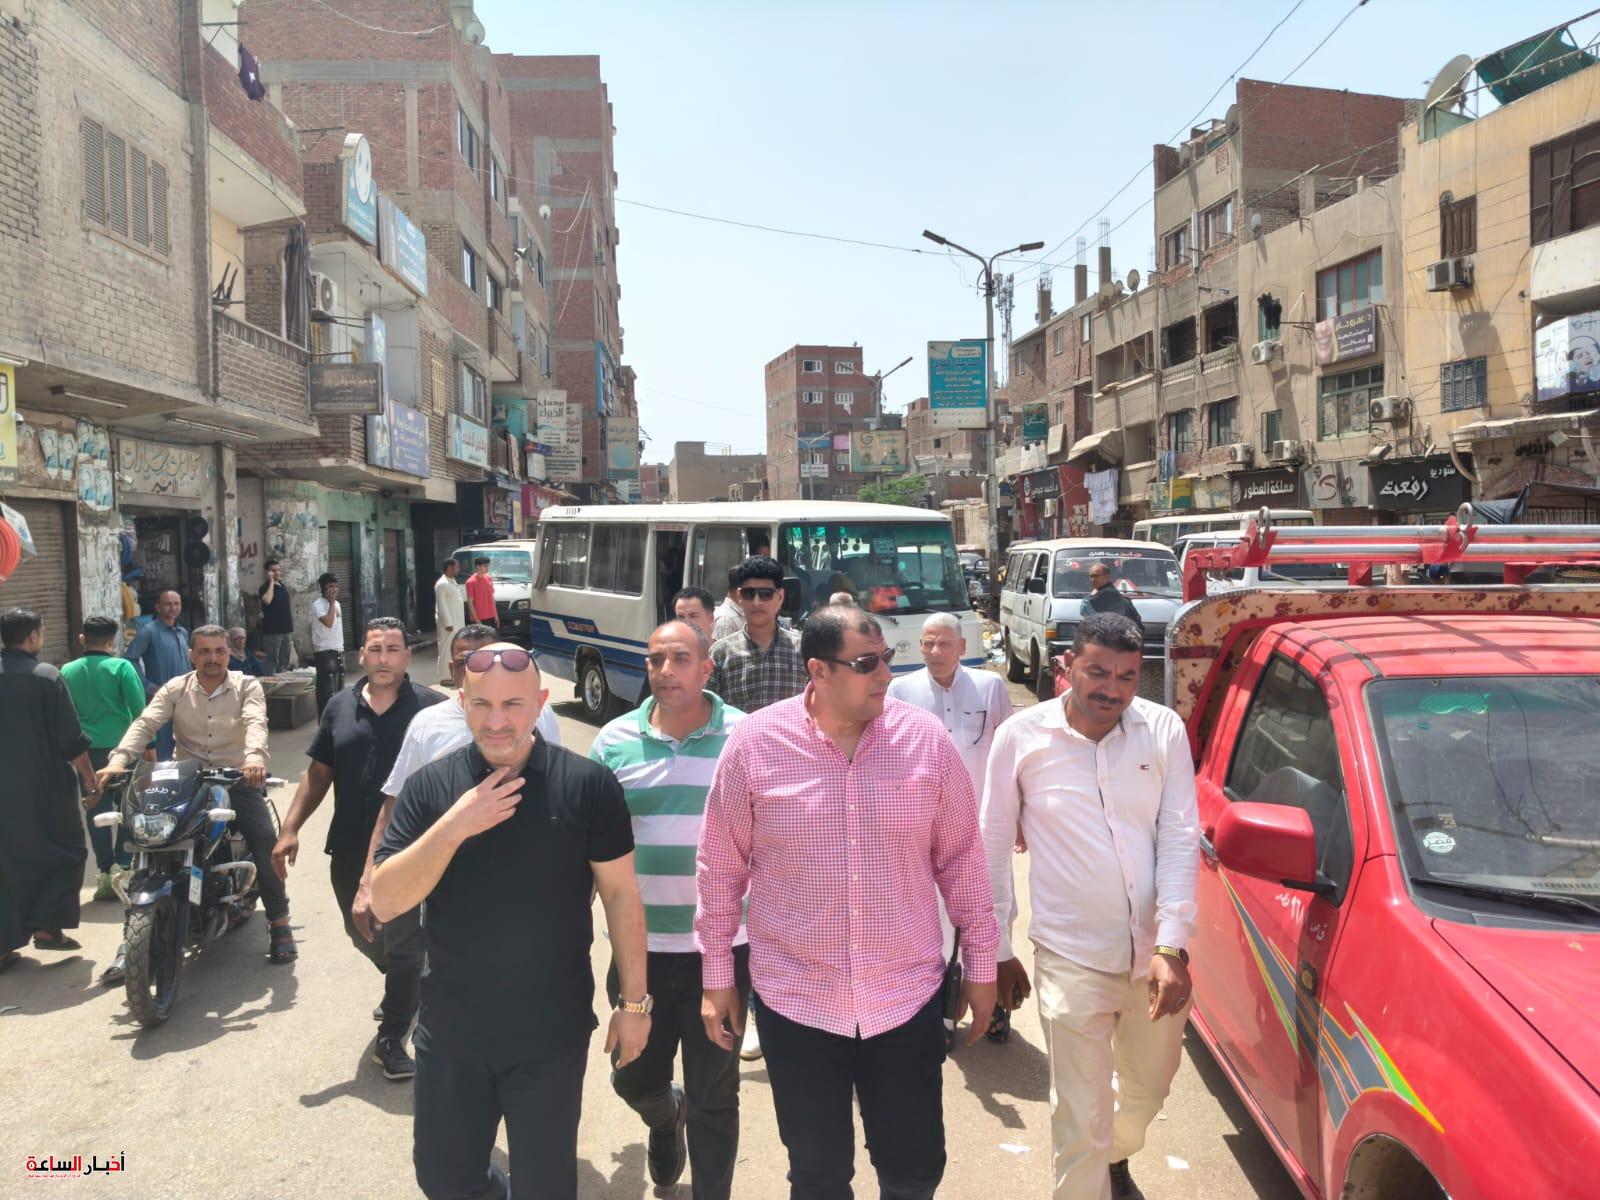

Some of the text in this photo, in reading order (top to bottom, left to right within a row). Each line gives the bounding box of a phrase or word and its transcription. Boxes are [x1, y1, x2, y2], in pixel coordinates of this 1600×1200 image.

[1430, 463, 1456, 478] ستوديو
[1243, 481, 1270, 499] العطور
[1270, 480, 1295, 495] مملكة
[1379, 475, 1428, 501] رفعت
[567, 621, 595, 633] COASTER
